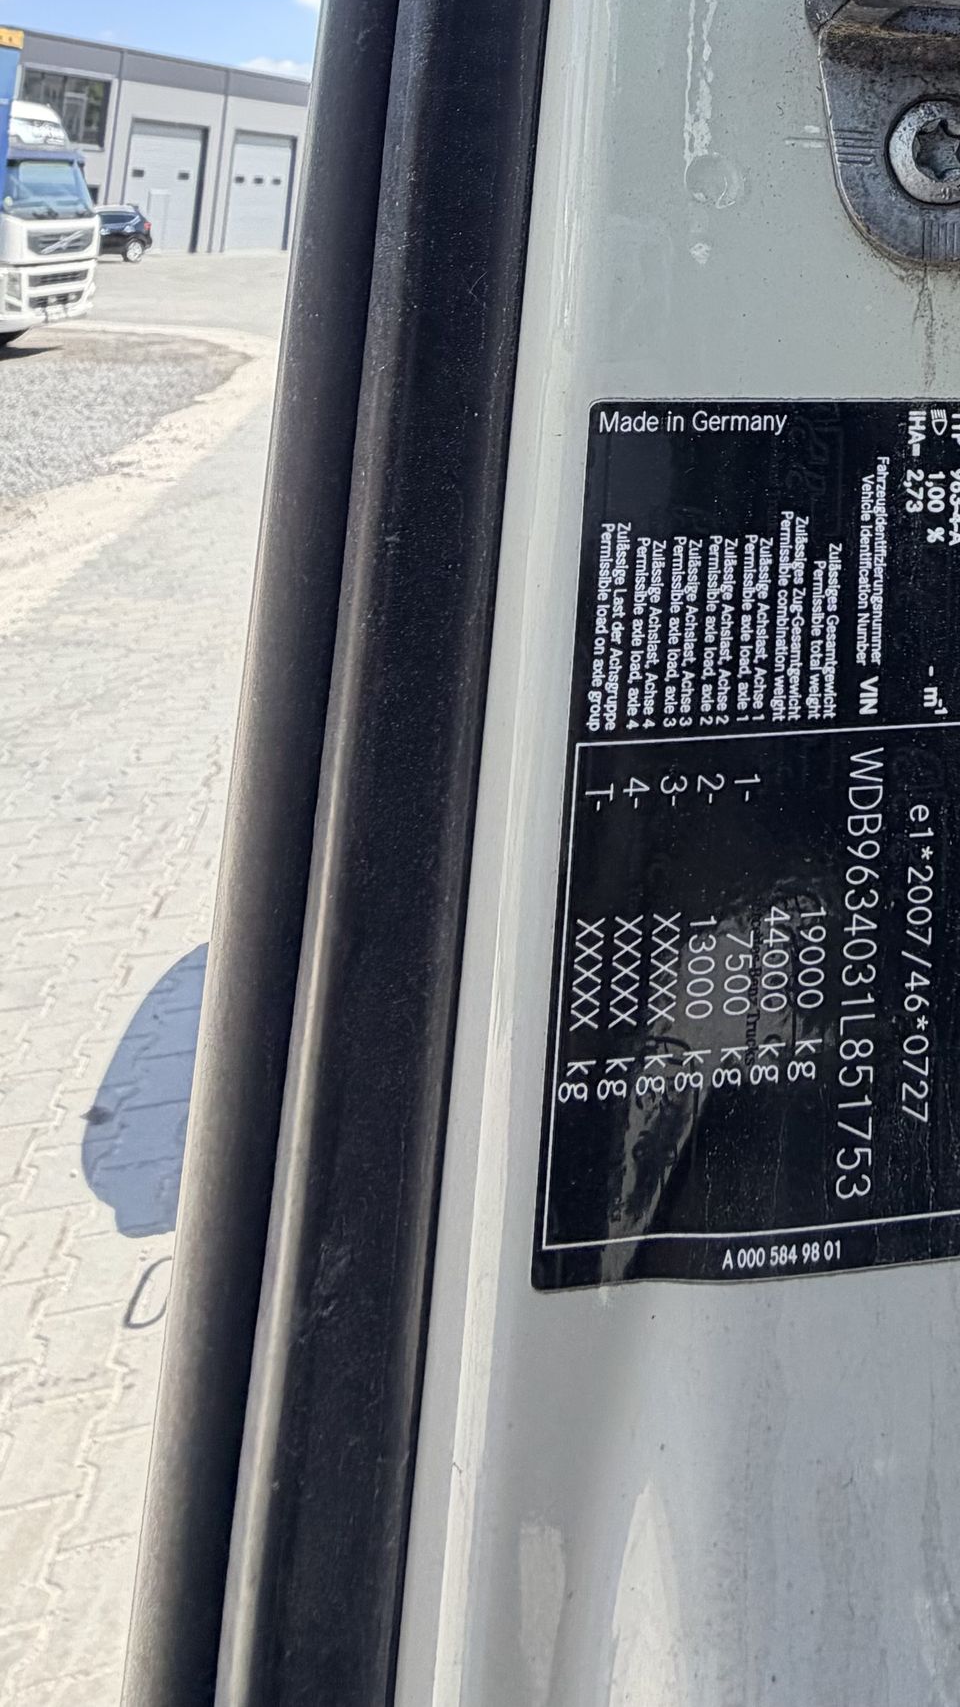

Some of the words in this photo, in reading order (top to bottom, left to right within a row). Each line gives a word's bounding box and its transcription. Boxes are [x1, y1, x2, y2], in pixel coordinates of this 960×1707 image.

[600, 411, 658, 434] Made
[666, 411, 685, 433] in
[692, 412, 787, 435] Germany
[859, 475, 873, 521] Vehicle
[905, 469, 923, 513] 2,73
[925, 471, 944, 512] 1,00
[612, 522, 630, 585] Zulässige
[777, 511, 793, 586] Permissible
[791, 516, 808, 584] Zulässiges
[926, 528, 943, 543] %
[596, 523, 613, 601] Permissible
[632, 537, 649, 615] Permissible
[648, 540, 666, 603] Zulässige
[669, 537, 685, 613] Permissible
[684, 539, 702, 601] Zulässige
[705, 536, 722, 611] Permissible
[721, 538, 738, 600] Zulässige
[741, 535, 756, 610] Permissible
[756, 538, 773, 599] Zulässige
[826, 543, 842, 612] Zulässiges
[857, 525, 872, 610] Identification
[869, 457, 889, 665] Fahrzeugidentifizierungsnummer
[594, 604, 611, 633] load
[612, 588, 627, 618] Last
[810, 561, 826, 636] Permissible
[593, 638, 608, 655] on
[610, 622, 625, 644] der
[630, 619, 645, 646] axle
[644, 607, 663, 669] Achslast,
[667, 617, 682, 644] axle
[680, 605, 699, 666] Achslast,
[704, 615, 718, 642] axle
[718, 603, 735, 664] Achslast,
[739, 614, 753, 641] axle
[752, 602, 770, 663] Achslast,
[773, 591, 790, 672] combination
[856, 613, 870, 666] Number
[591, 659, 607, 687] axle
[626, 651, 644, 683] load,
[664, 649, 681, 682] load,
[700, 647, 716, 680] load,
[737, 645, 752, 678] load,
[786, 587, 805, 721] Zug-Gesamtgewicht
[809, 639, 823, 670] total
[822, 615, 837, 718] Gesamtgewicht
[604, 648, 623, 730] Achsgruppe
[626, 688, 641, 716] axle
[643, 673, 658, 715] Achse
[663, 686, 678, 714] axle
[680, 670, 695, 713] Achse
[700, 684, 714, 712] axle
[716, 669, 731, 711] Achse
[737, 683, 750, 710] axle
[751, 668, 767, 709] Achse
[770, 675, 786, 721] weight
[805, 673, 821, 719] weight
[859, 677, 878, 714] VIN
[586, 691, 604, 731] group
[625, 716, 639, 729] 4
[642, 719, 655, 728] 4
[663, 717, 676, 727] 3
[679, 717, 692, 727] 3
[699, 717, 713, 726] 2
[715, 716, 728, 724] 2
[685, 915, 717, 1019] 13000
[723, 933, 754, 1016] 7500
[760, 905, 791, 1012] 44000
[797, 906, 826, 1009] 19000
[836, 747, 884, 1199] WDB9634031L851753
[597, 1057, 635, 1099] kg
[636, 1053, 673, 1095] kg
[674, 1051, 711, 1091] kg
[712, 1046, 748, 1087] kg
[750, 1042, 786, 1085] kg
[787, 1039, 822, 1082] kg
[558, 1061, 596, 1103] kg
[722, 1248, 734, 1269] A
[737, 1246, 766, 1268] 000
[770, 1243, 798, 1265] 584
[802, 1242, 820, 1263] 98
[824, 1241, 841, 1261] 01
